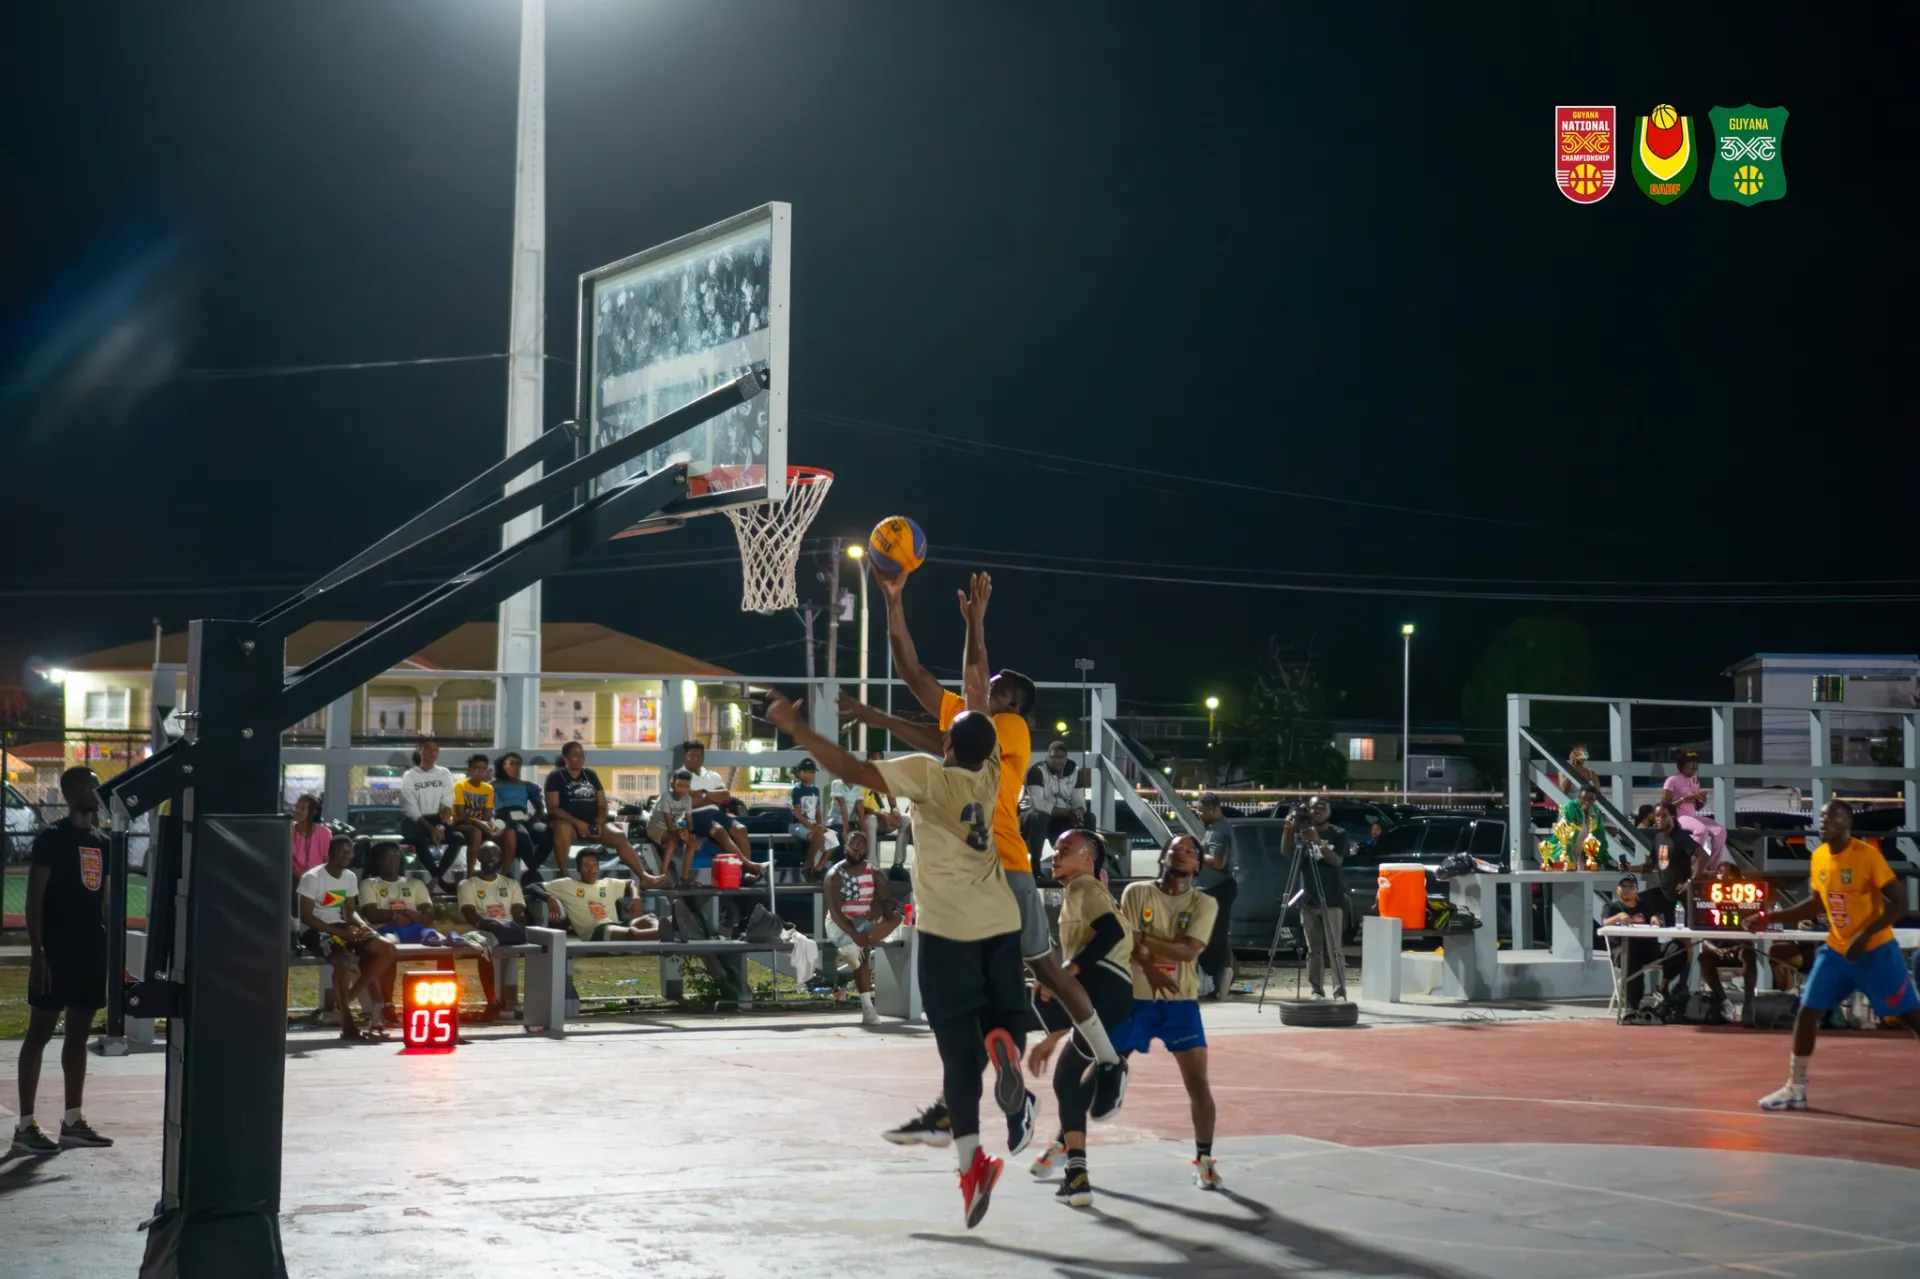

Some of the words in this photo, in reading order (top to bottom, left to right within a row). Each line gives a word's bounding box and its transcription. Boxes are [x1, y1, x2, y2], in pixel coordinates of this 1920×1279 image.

[414, 779, 444, 792] SUPER
[960, 801, 989, 852] 3
[1710, 883, 1756, 903] 6:09
[1696, 901, 1717, 909] HOME
[1738, 902, 1761, 910] GUEST
[410, 1009, 451, 1043] 05
